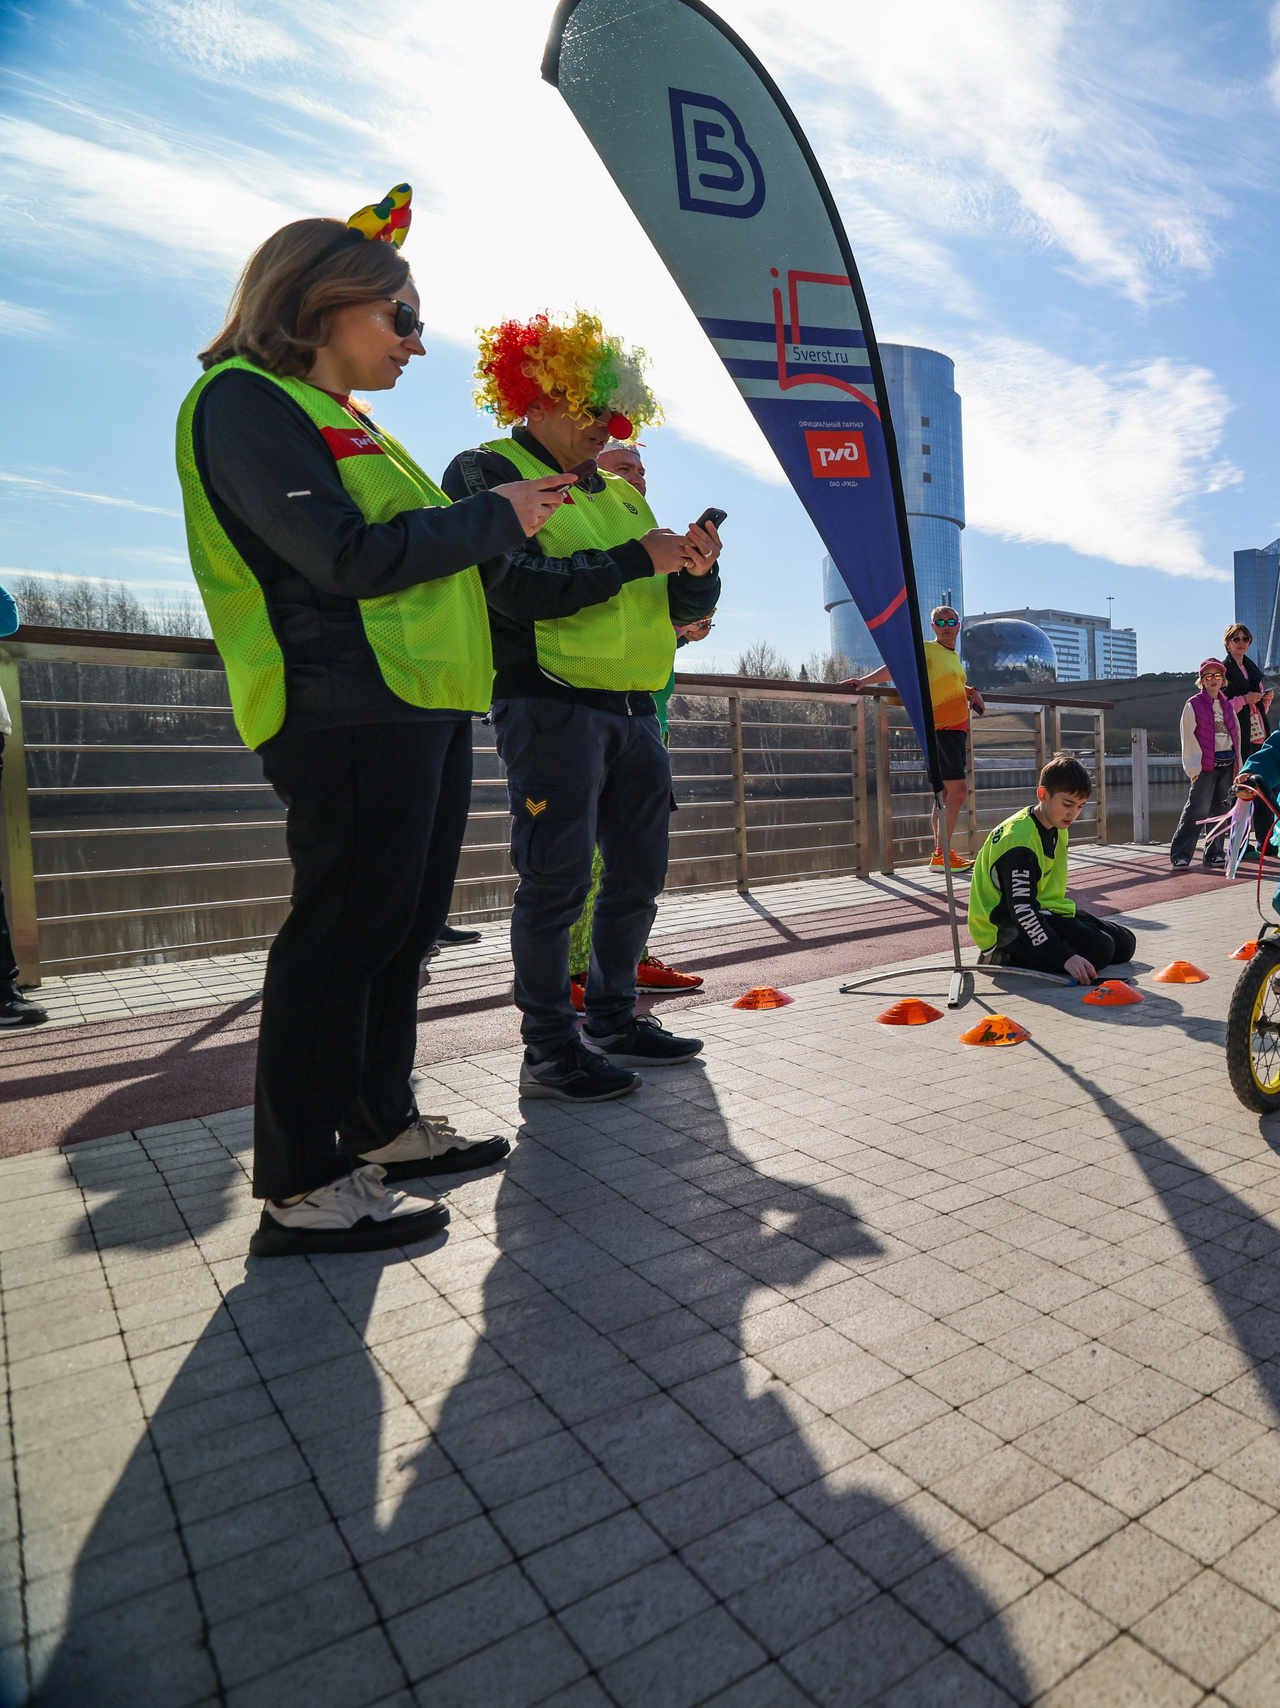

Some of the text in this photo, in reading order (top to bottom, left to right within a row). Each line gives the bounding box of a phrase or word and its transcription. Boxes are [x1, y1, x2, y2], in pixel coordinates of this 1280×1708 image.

[793, 346, 849, 364] 5verst.ru
[798, 420, 841, 428] ОФИЦИАЛЬНЫЙ
[829, 480, 840, 488] ОАО
[1011, 869, 1049, 947] BRKLN NYC
